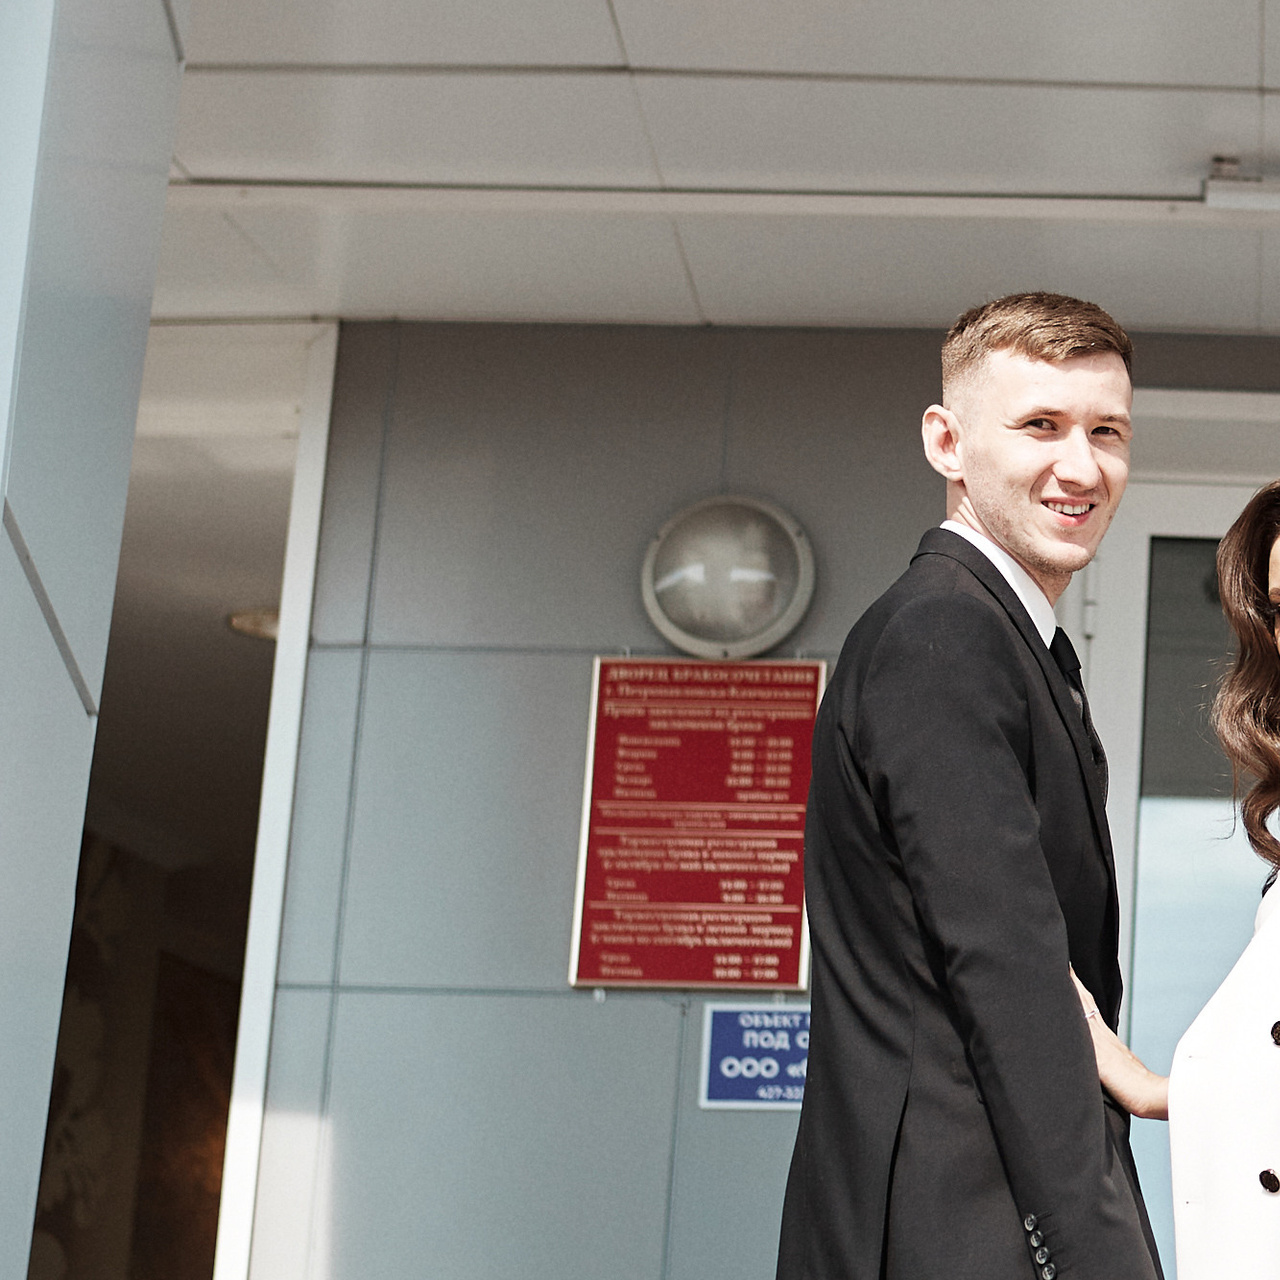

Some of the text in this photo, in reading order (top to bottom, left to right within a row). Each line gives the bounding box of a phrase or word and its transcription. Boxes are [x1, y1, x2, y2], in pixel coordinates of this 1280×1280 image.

[738, 1013, 802, 1028] ОБЪЕКТ
[743, 1030, 790, 1051] ПОД
[720, 1056, 780, 1079] ООО
